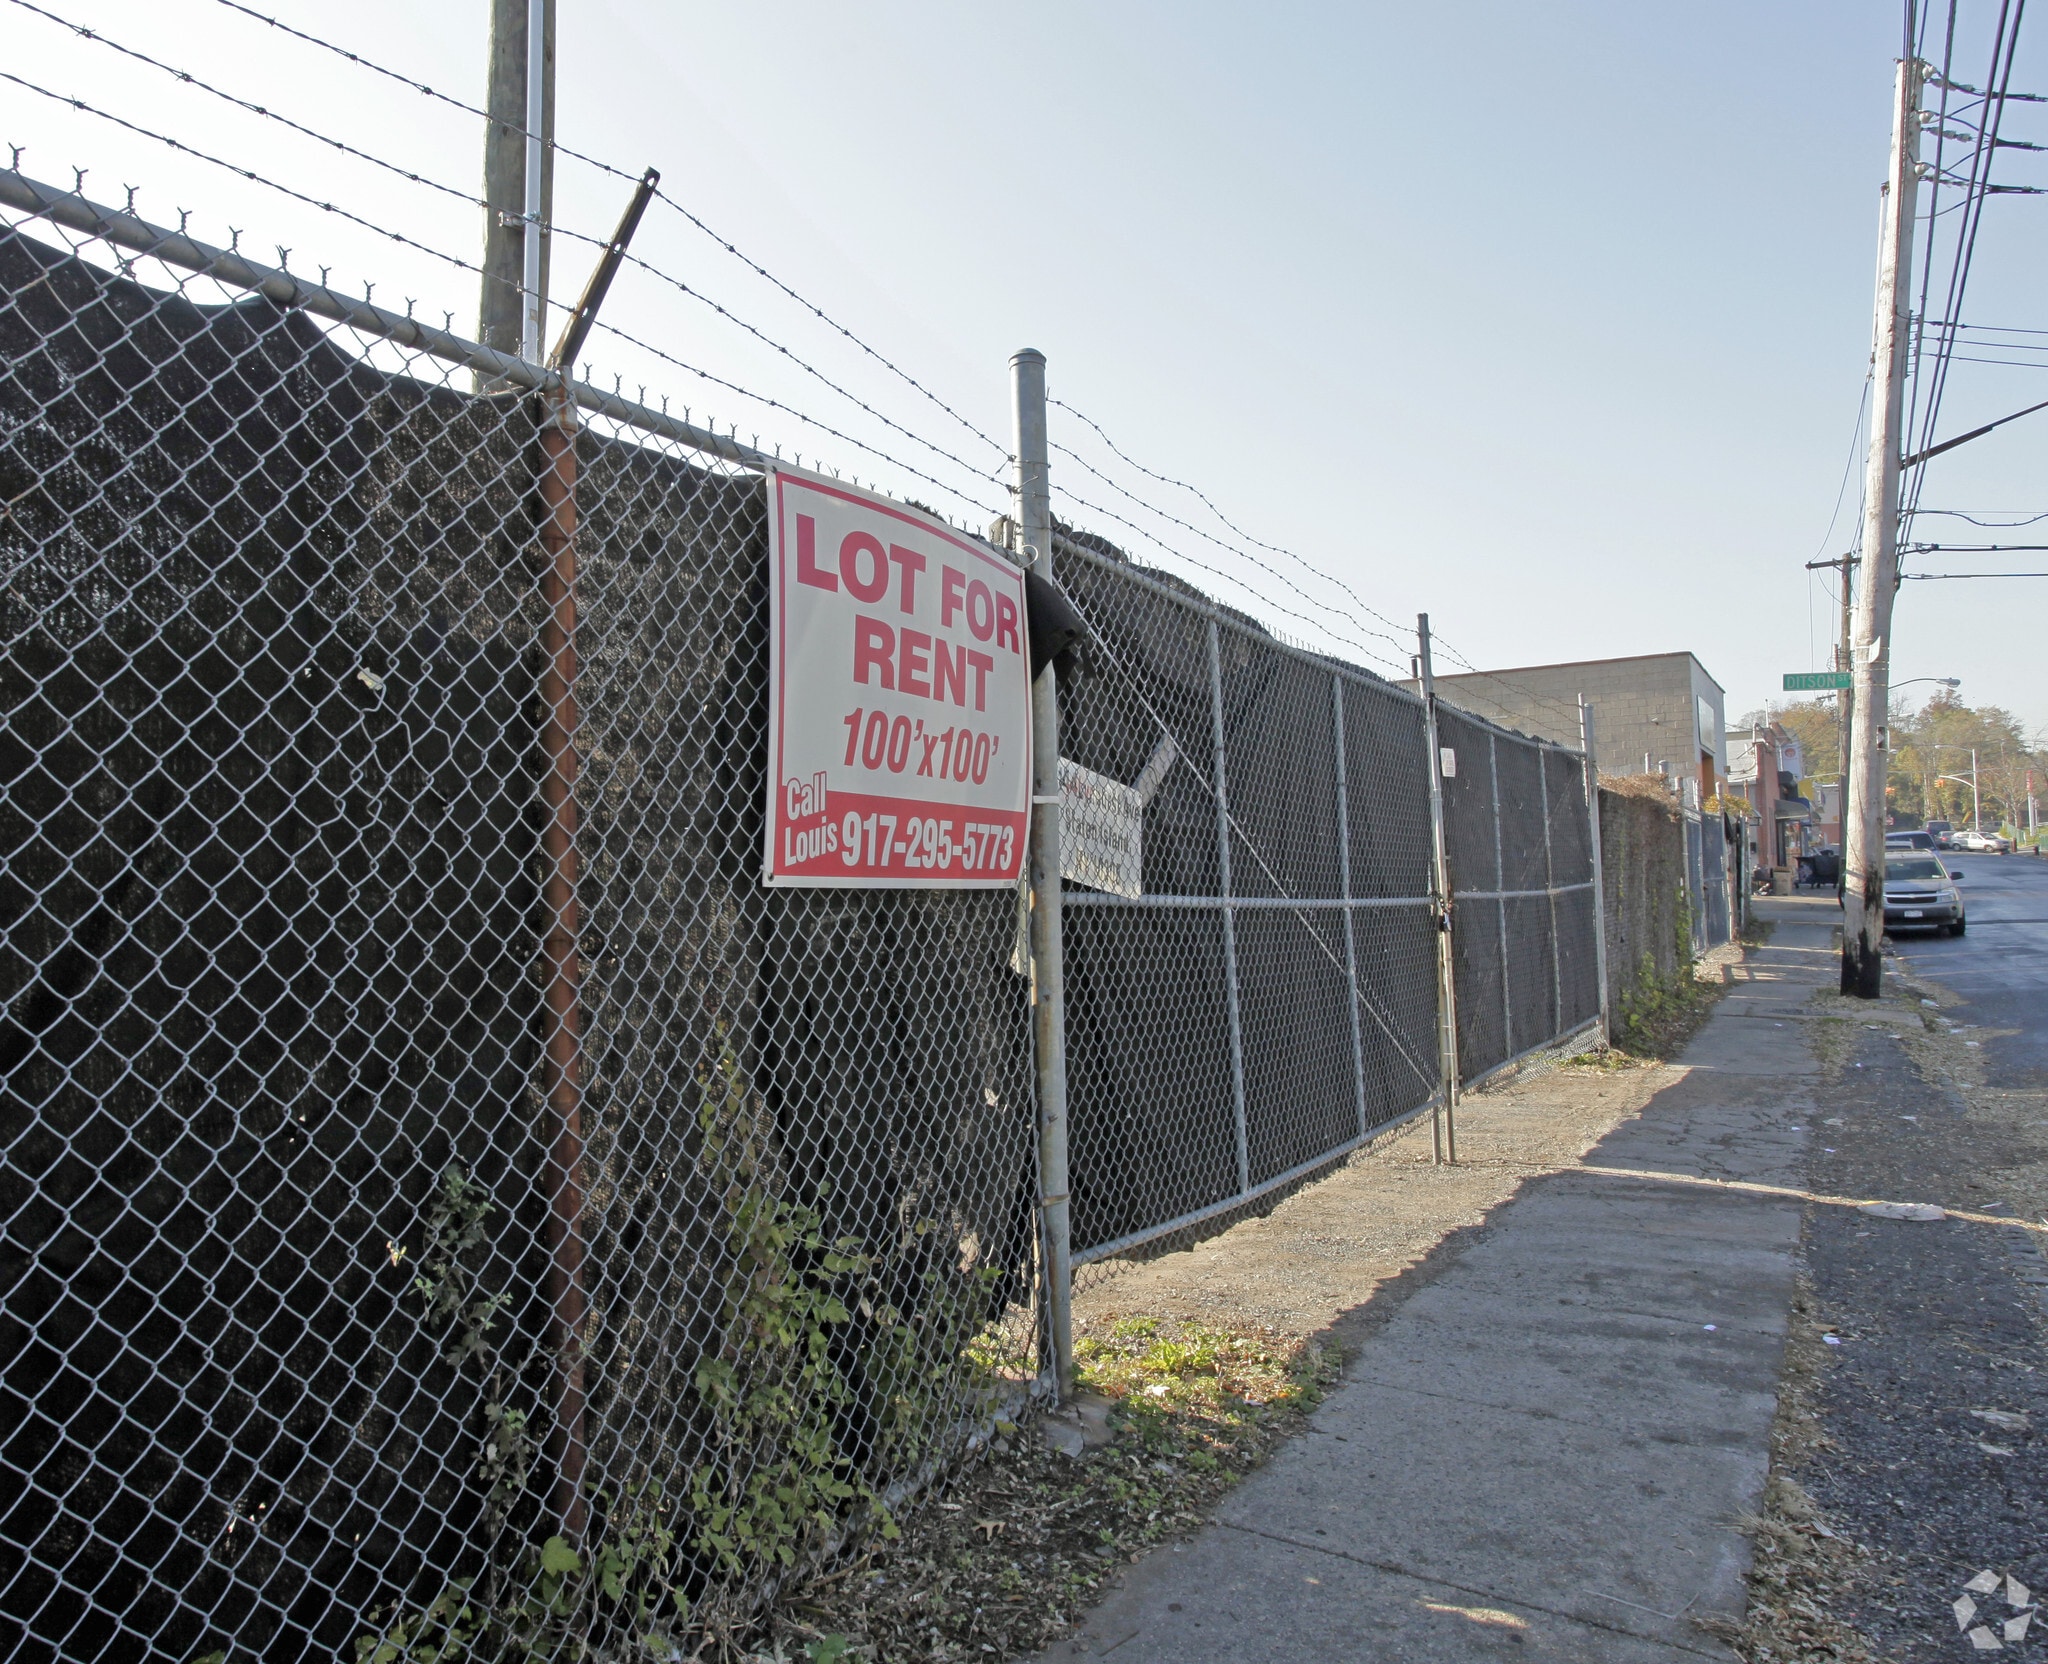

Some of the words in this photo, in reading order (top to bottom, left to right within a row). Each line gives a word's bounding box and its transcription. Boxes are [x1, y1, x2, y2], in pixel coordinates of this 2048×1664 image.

[796, 513, 926, 615] LOT
[941, 564, 1020, 655] FOR
[853, 614, 993, 712] RENT
[1787, 675, 1836, 689] DITSON
[1836, 674, 1847, 682] ST
[843, 708, 999, 785] 100'x100'
[786, 771, 827, 821] Call
[784, 821, 837, 867] Louis
[841, 811, 1013, 870] 917-295-5773
